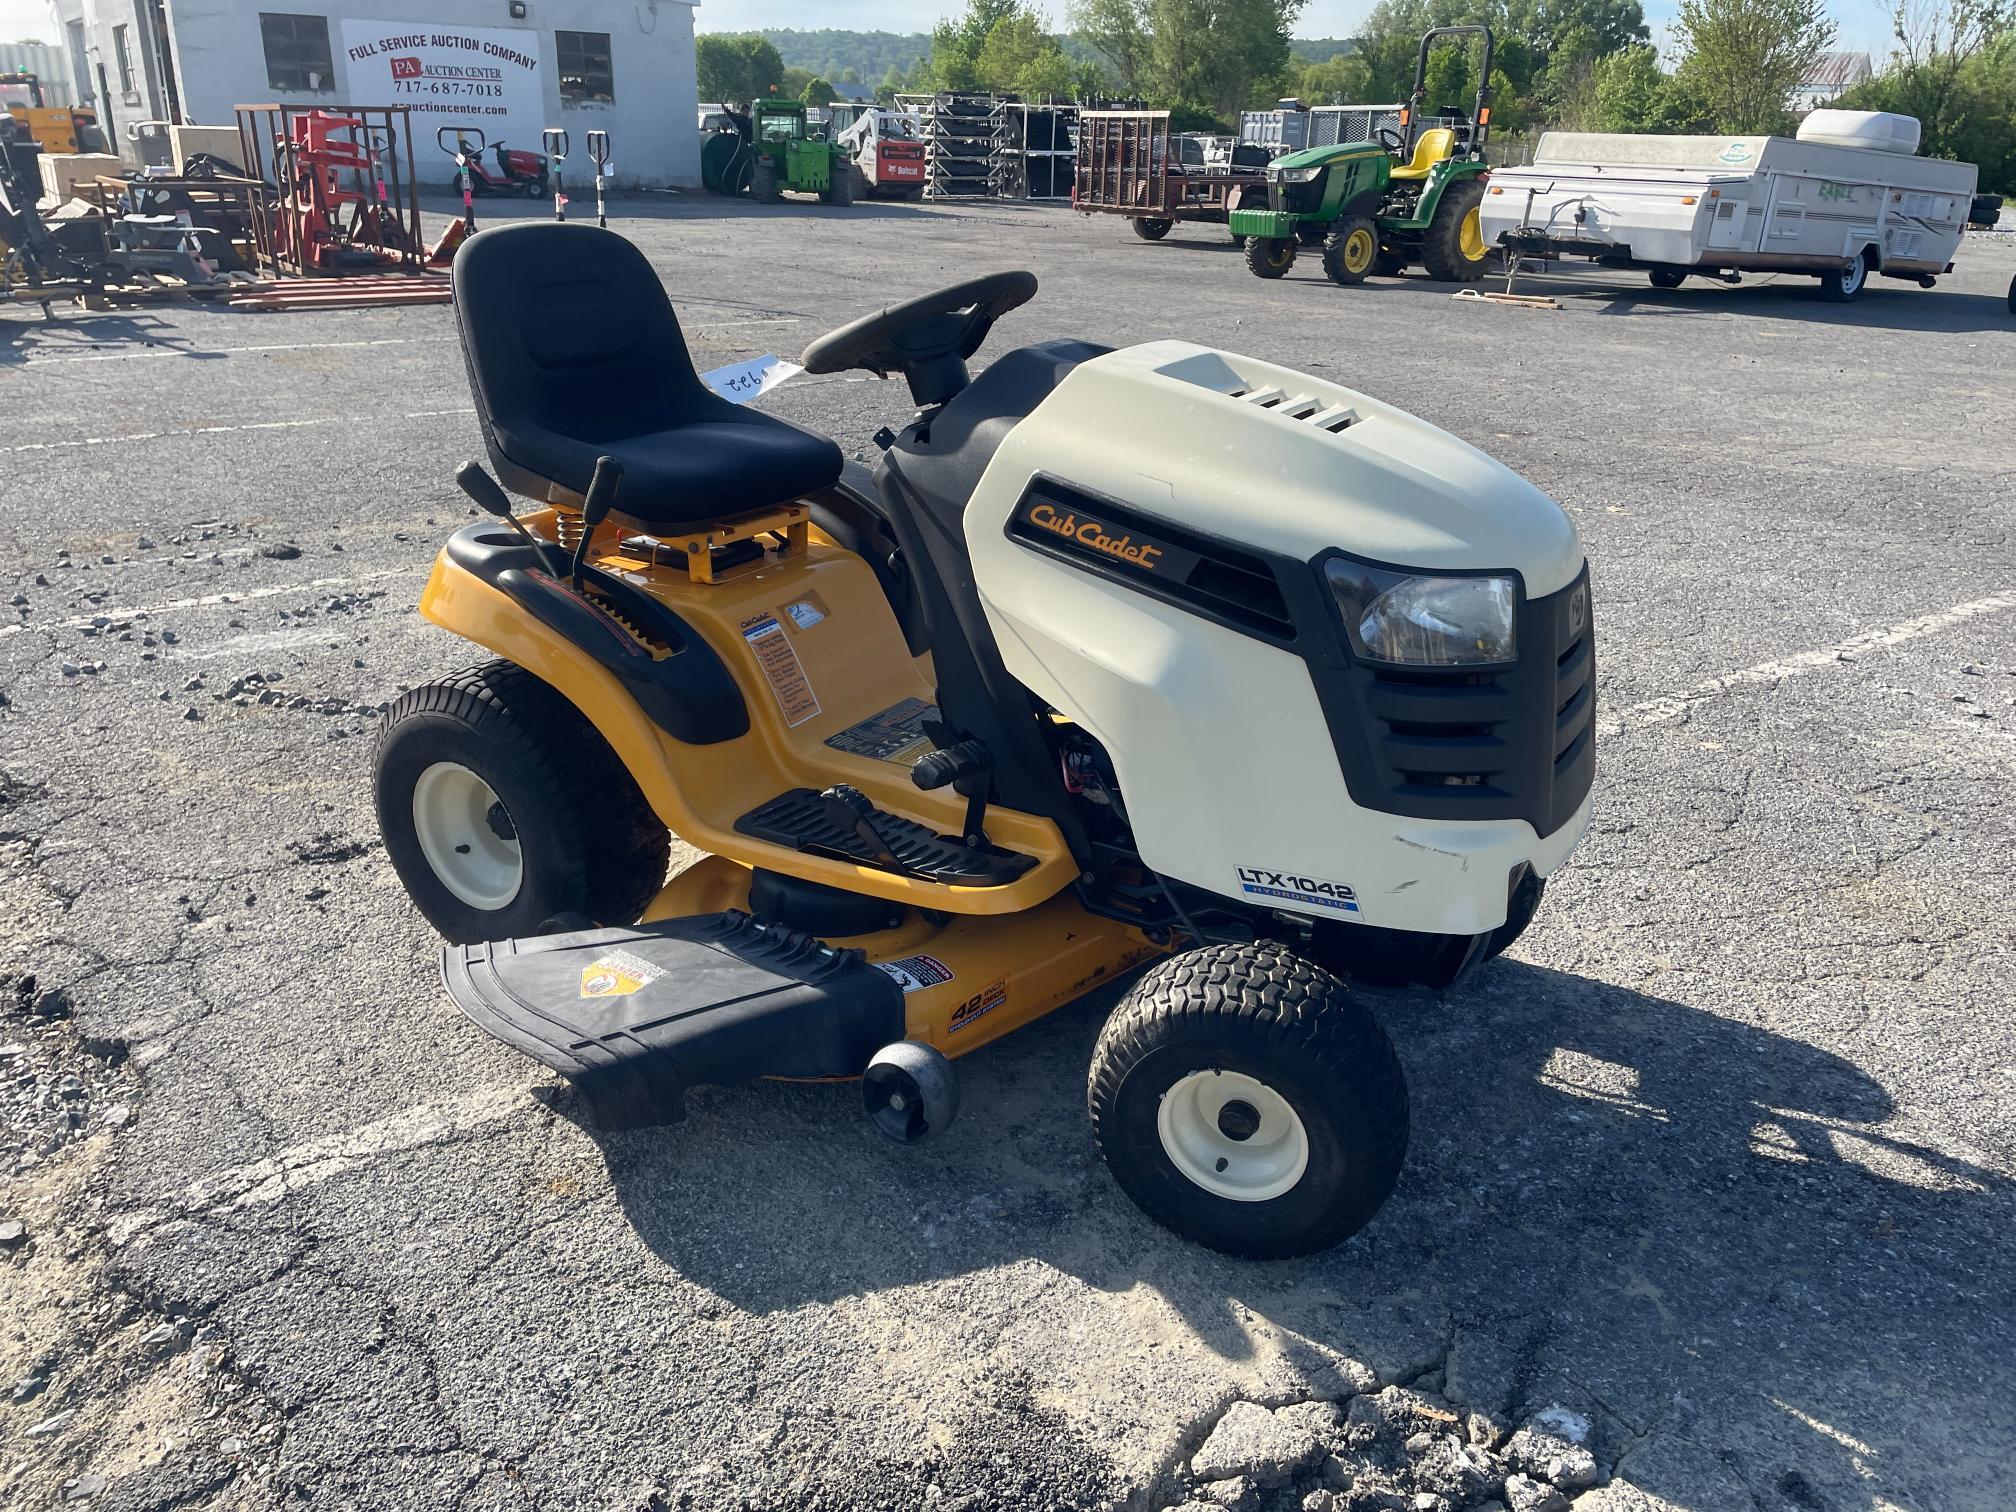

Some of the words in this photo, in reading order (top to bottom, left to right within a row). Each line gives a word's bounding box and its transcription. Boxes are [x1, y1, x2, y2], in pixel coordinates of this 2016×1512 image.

[349, 43, 378, 62] FULL
[379, 34, 427, 52] SERVICE
[431, 34, 480, 51] AUCTION
[483, 42, 537, 71] COMPANY
[394, 60, 416, 75] PA
[424, 64, 464, 78] AUCTION
[465, 66, 502, 79] CENTER
[393, 80, 503, 97] 717-687-7018
[1237, 868, 1356, 901] LTX1042
[1253, 887, 1348, 909] HYDROSTATIC
[952, 994, 982, 1020] 42
